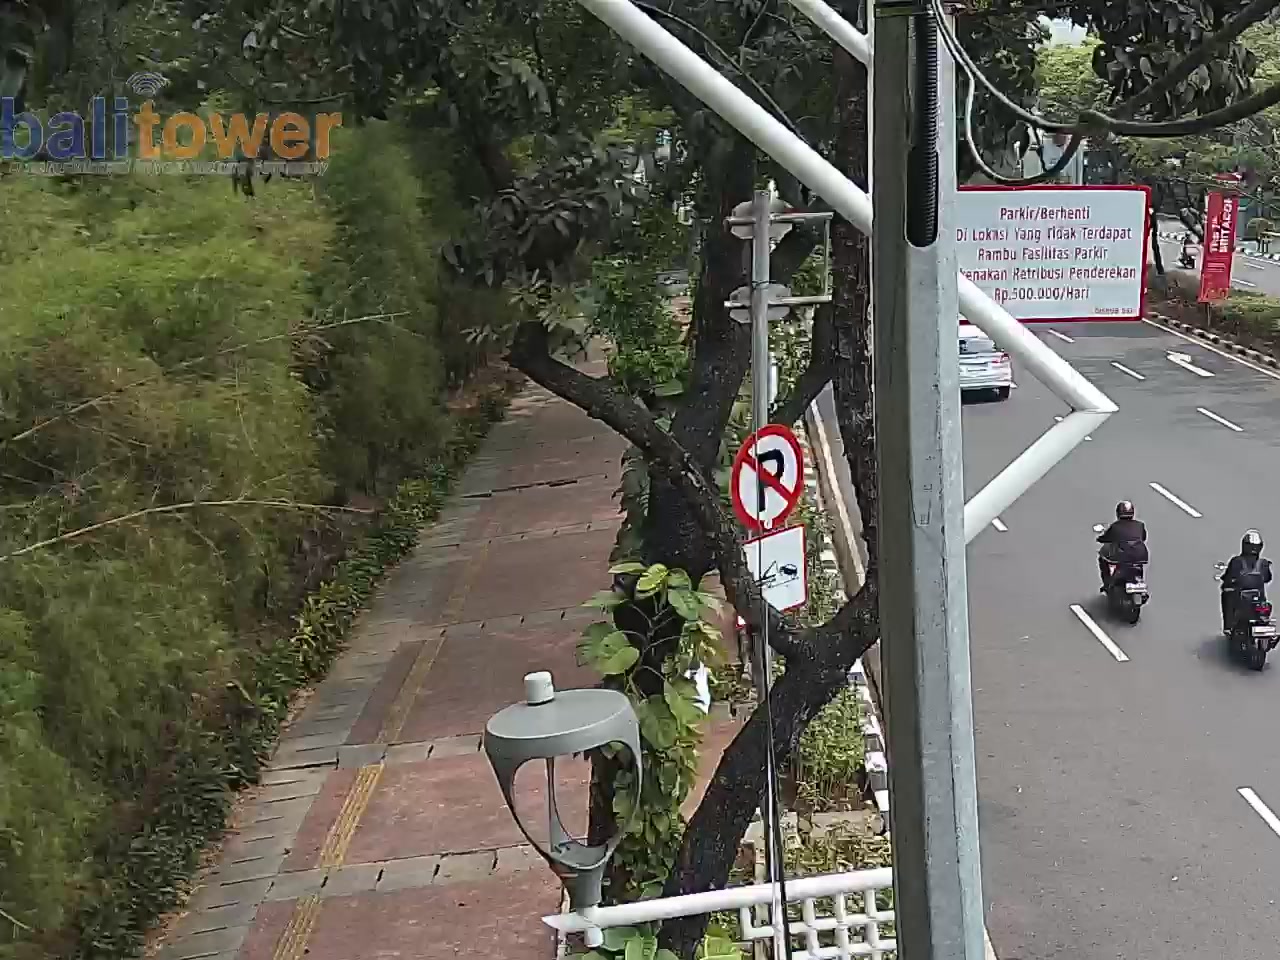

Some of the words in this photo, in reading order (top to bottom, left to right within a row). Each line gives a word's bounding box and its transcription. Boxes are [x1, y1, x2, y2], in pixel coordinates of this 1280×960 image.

[1000, 206, 1090, 220] Parkir/Berhenti
[972, 228, 1009, 241] Lokasi
[1014, 228, 1041, 243] Yang
[1047, 228, 1077, 240] Tidak
[1081, 227, 1132, 242] Terdapat
[978, 248, 1017, 261] Rambu
[1022, 247, 1069, 261] Fasilitas
[1074, 246, 1109, 260] Parkir
[1013, 267, 1064, 280] Retribusi
[1069, 266, 1136, 280] Penderekan
[994, 287, 1090, 303] Rp.500.000/Hari
